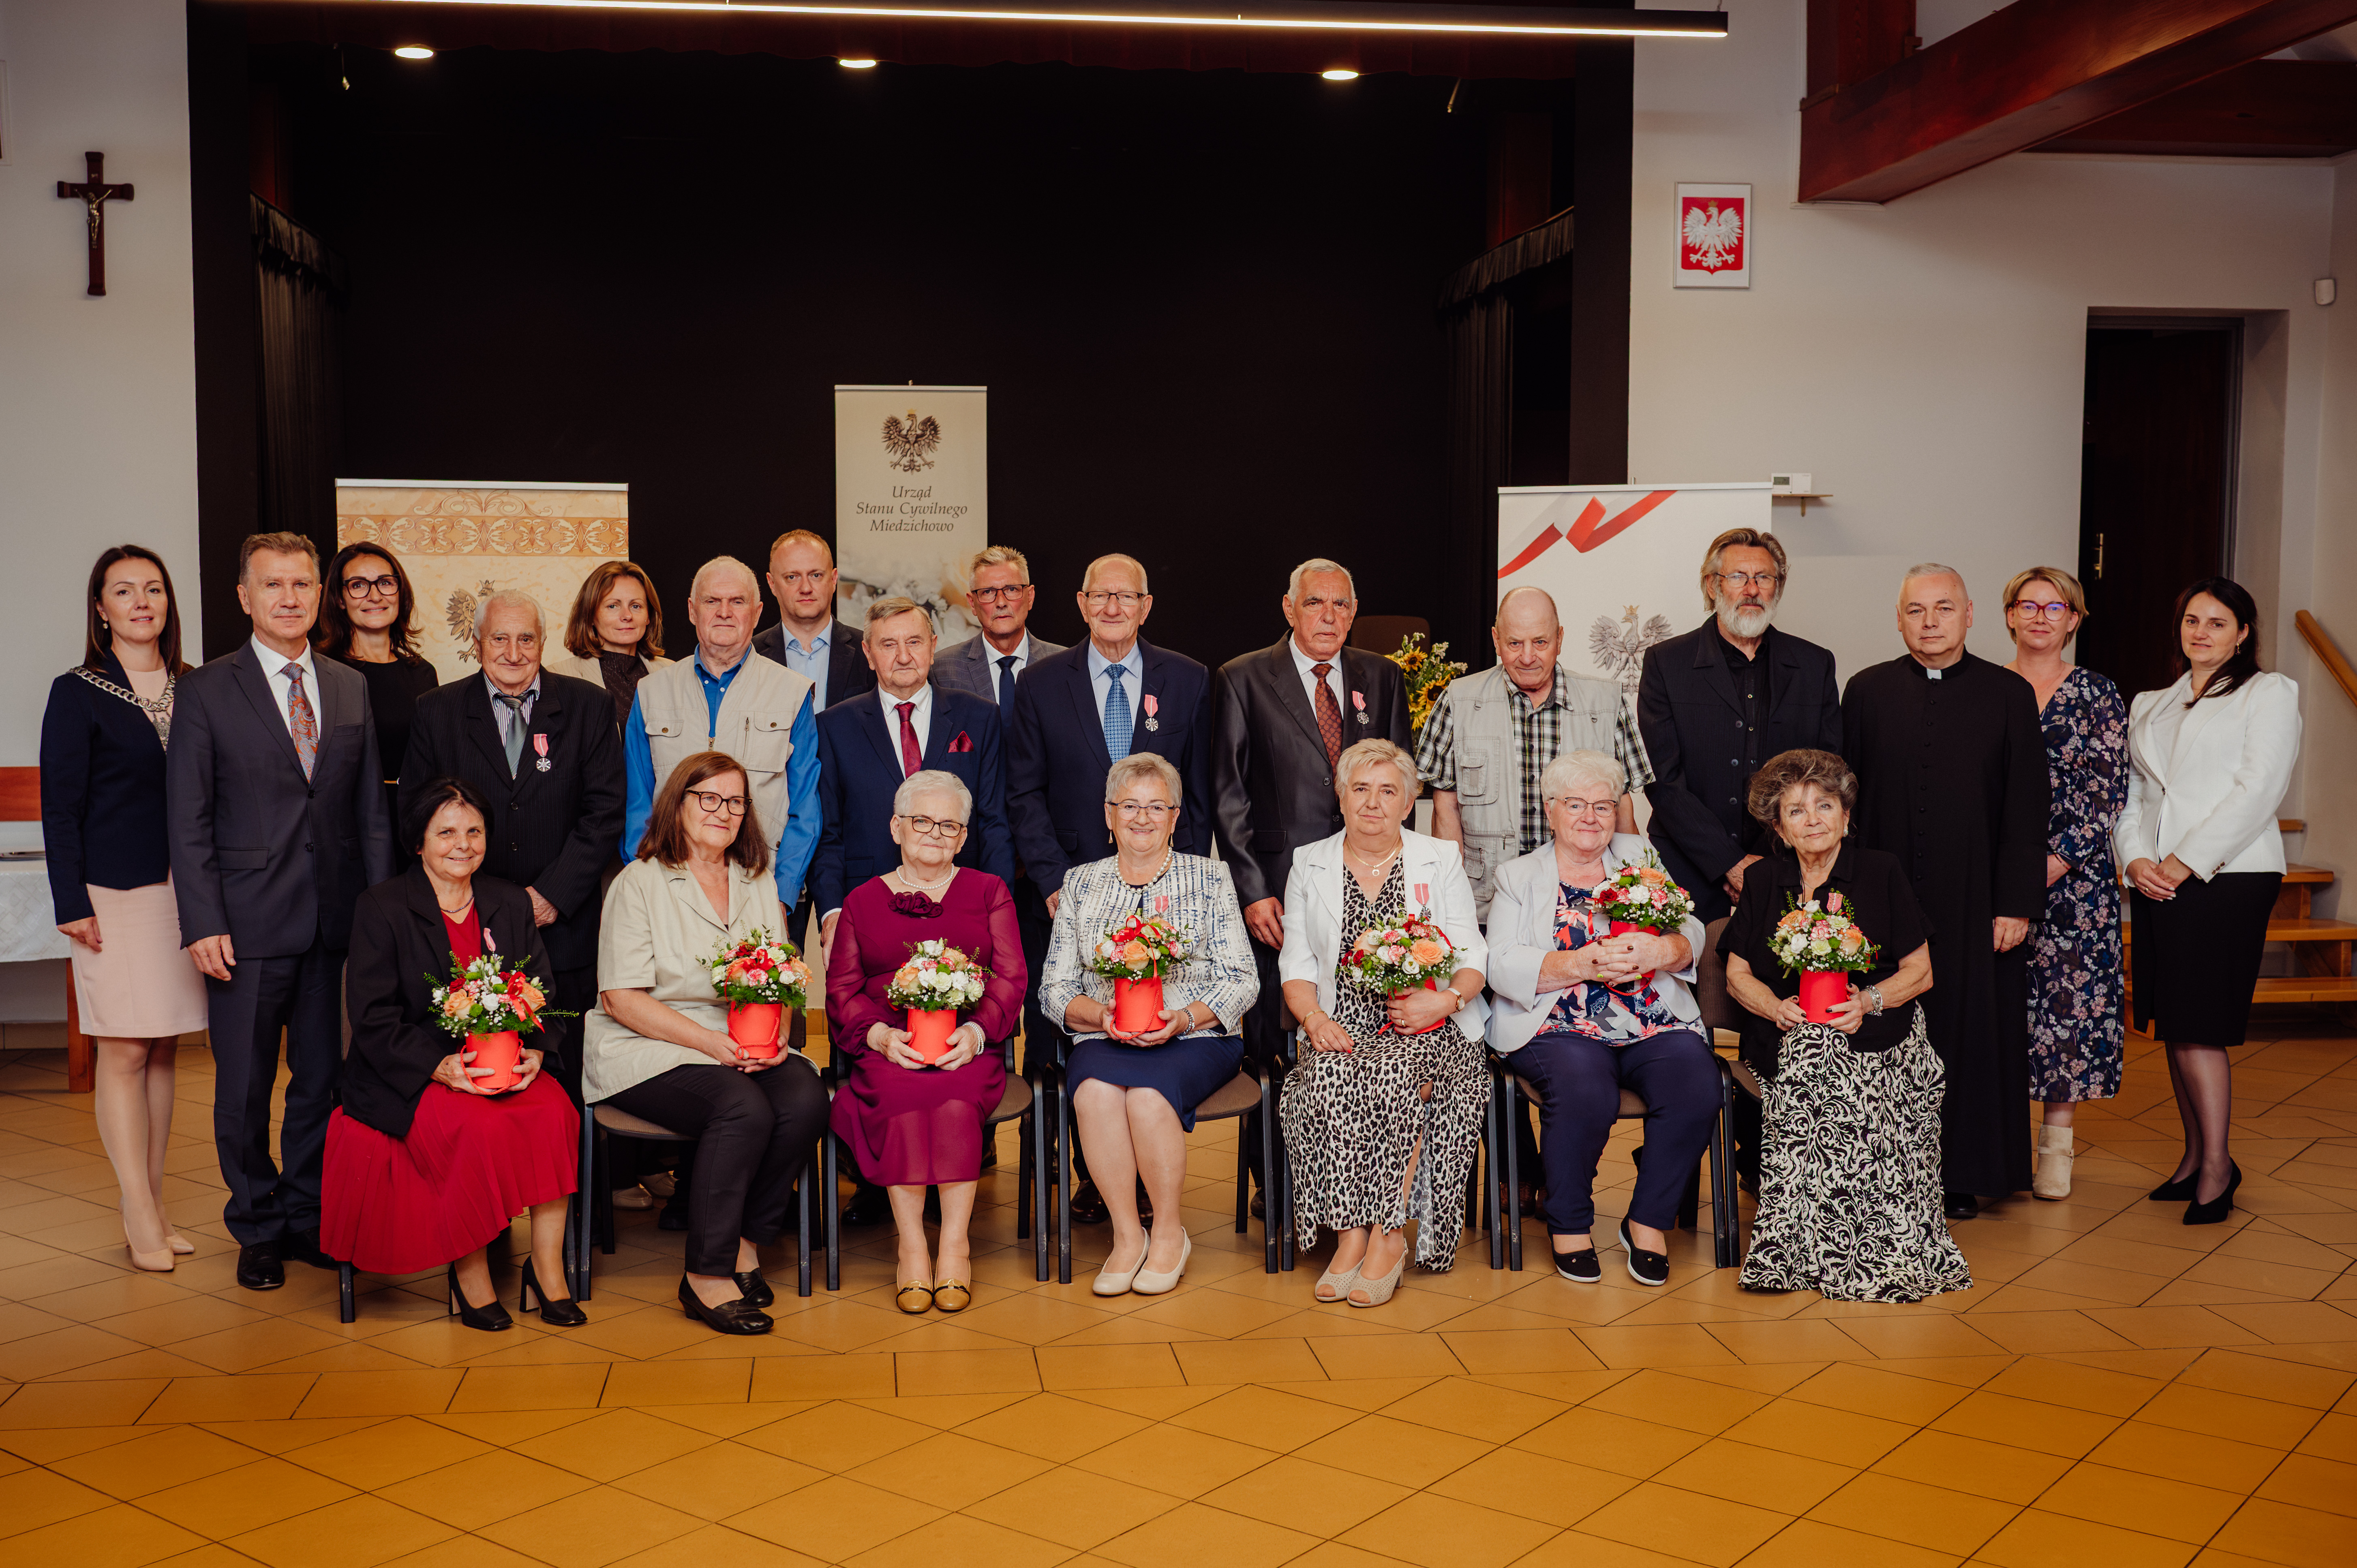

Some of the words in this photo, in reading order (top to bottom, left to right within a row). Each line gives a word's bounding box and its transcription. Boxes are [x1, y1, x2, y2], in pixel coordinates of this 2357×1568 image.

[892, 486, 932, 501] Urząd
[856, 502, 894, 514] Stanu
[900, 502, 968, 519] Cywilnego
[870, 519, 954, 532] Miedzichowo
